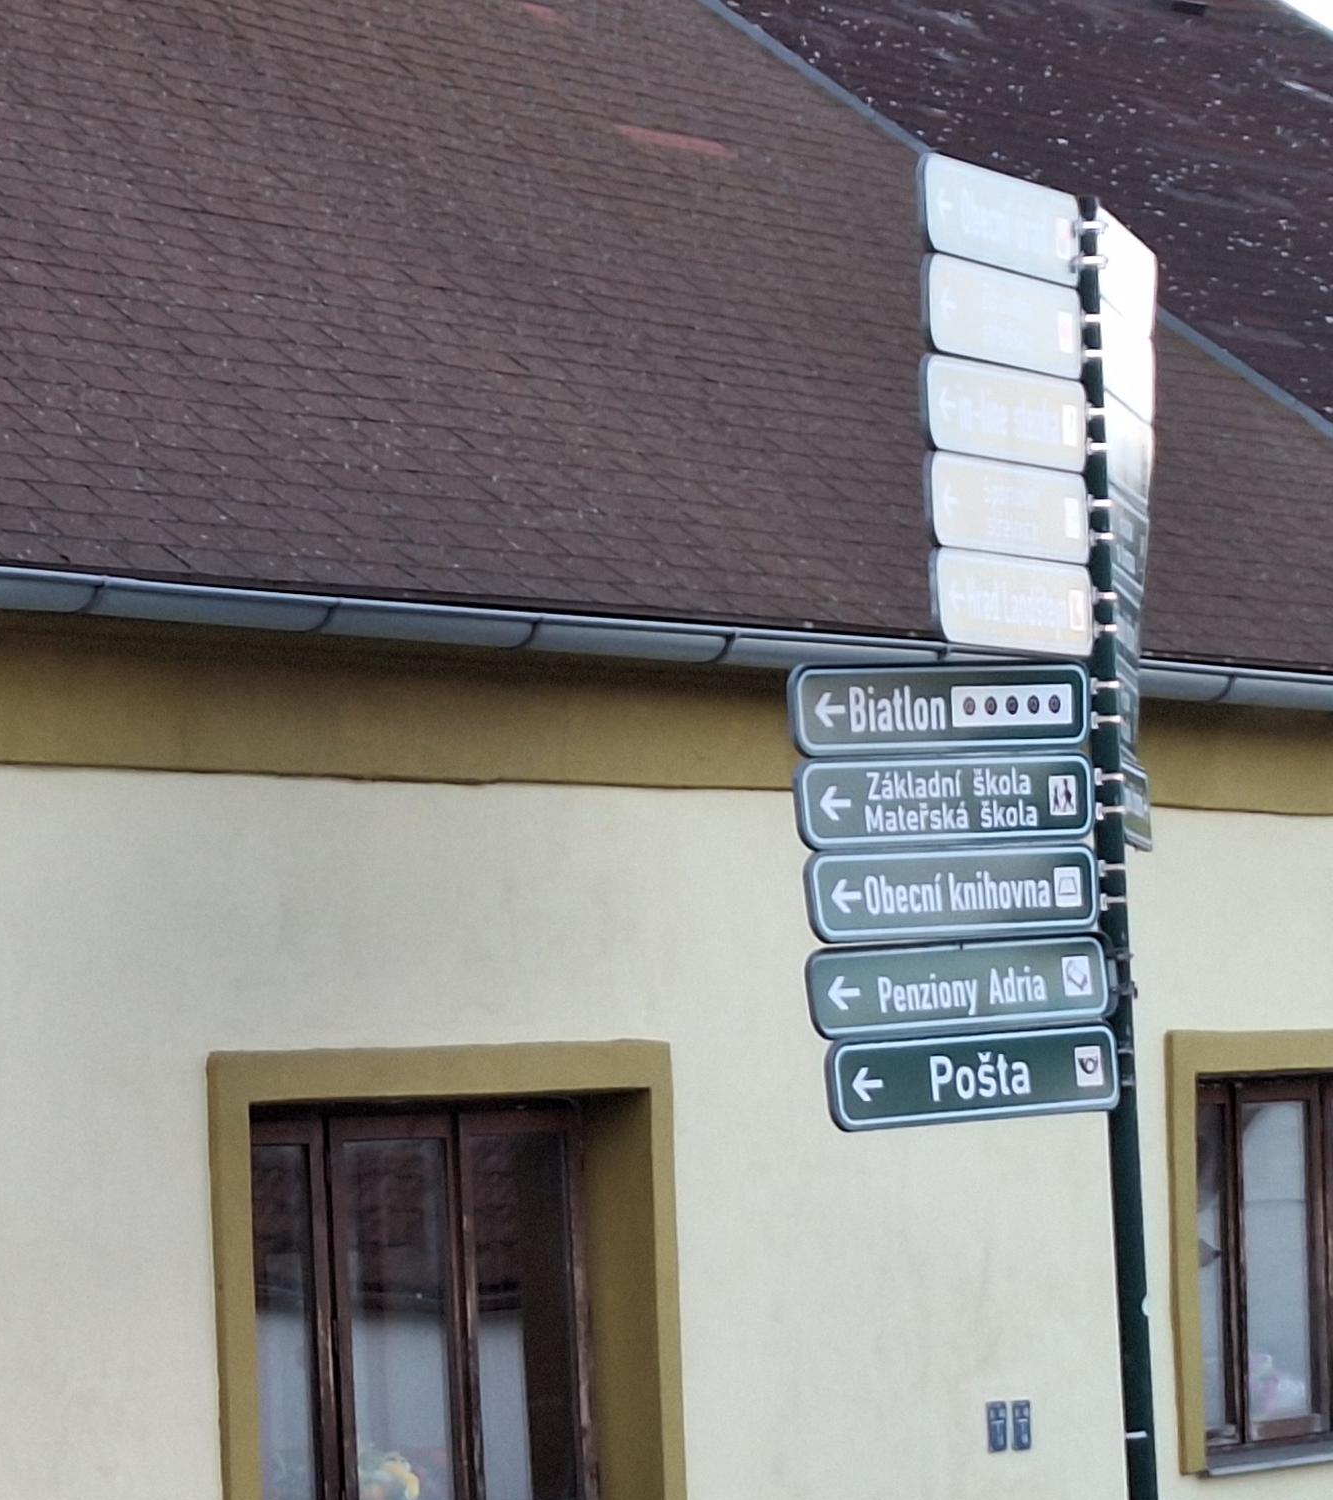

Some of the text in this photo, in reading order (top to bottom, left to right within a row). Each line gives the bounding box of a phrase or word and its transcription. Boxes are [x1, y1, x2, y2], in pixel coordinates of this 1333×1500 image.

[848, 685, 947, 734] Biatlon
[865, 768, 1032, 802] Základní škola
[864, 800, 1039, 833] Mateřská škola
[864, 867, 1052, 917] Obecní knihovna
[877, 967, 1048, 1016] Penziony Adria
[929, 1050, 1033, 1103] Pošta
